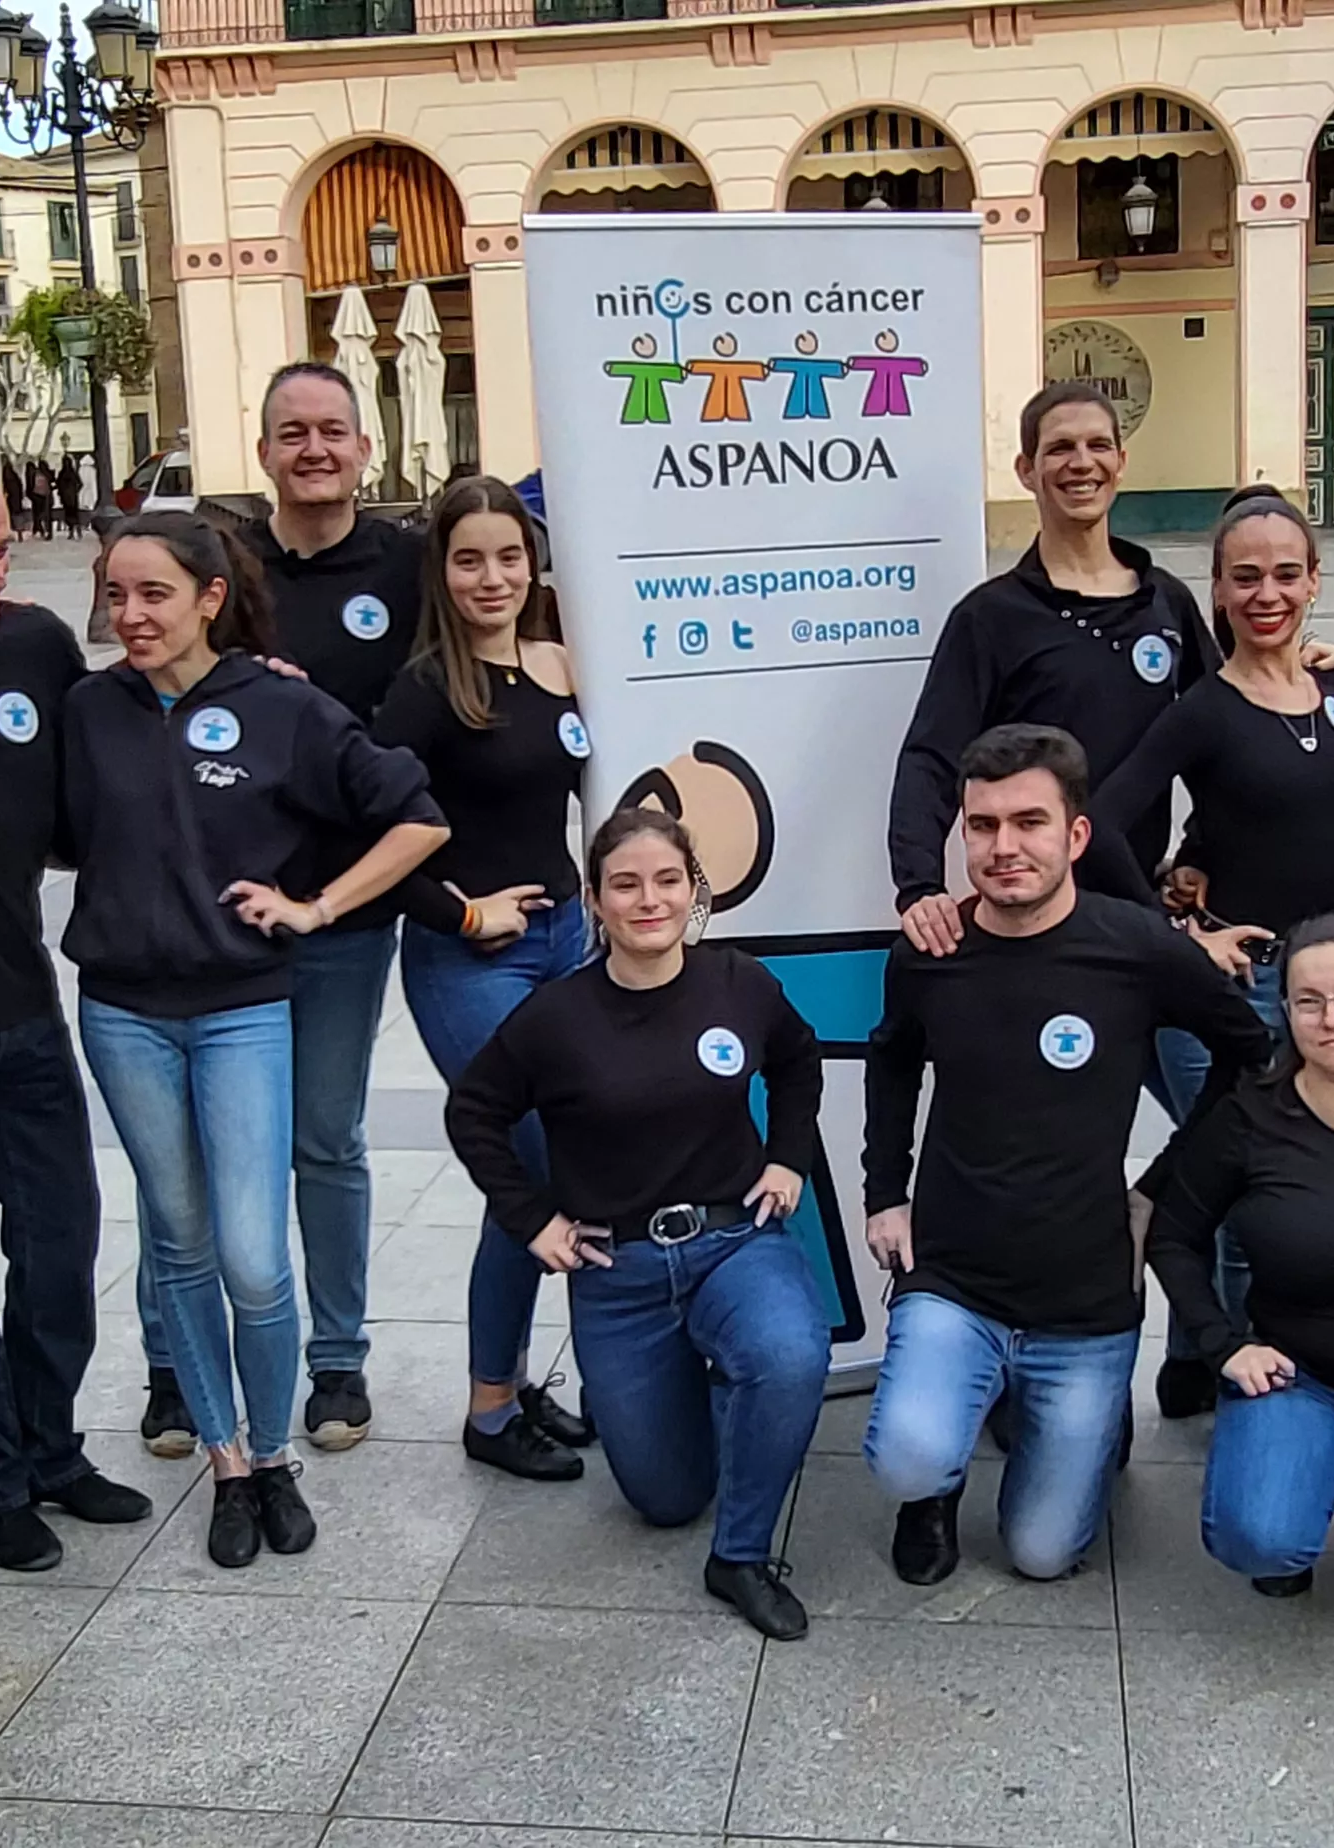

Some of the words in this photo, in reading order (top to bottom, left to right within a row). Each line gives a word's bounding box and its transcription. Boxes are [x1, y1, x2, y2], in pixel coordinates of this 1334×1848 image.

[725, 287, 792, 316] con
[804, 283, 925, 313] cáncer
[1074, 349, 1092, 377] LA
[652, 437, 898, 490] ASPANOA
[635, 563, 916, 600] www.aspanoa.org
[791, 618, 921, 645] @aspanoa
